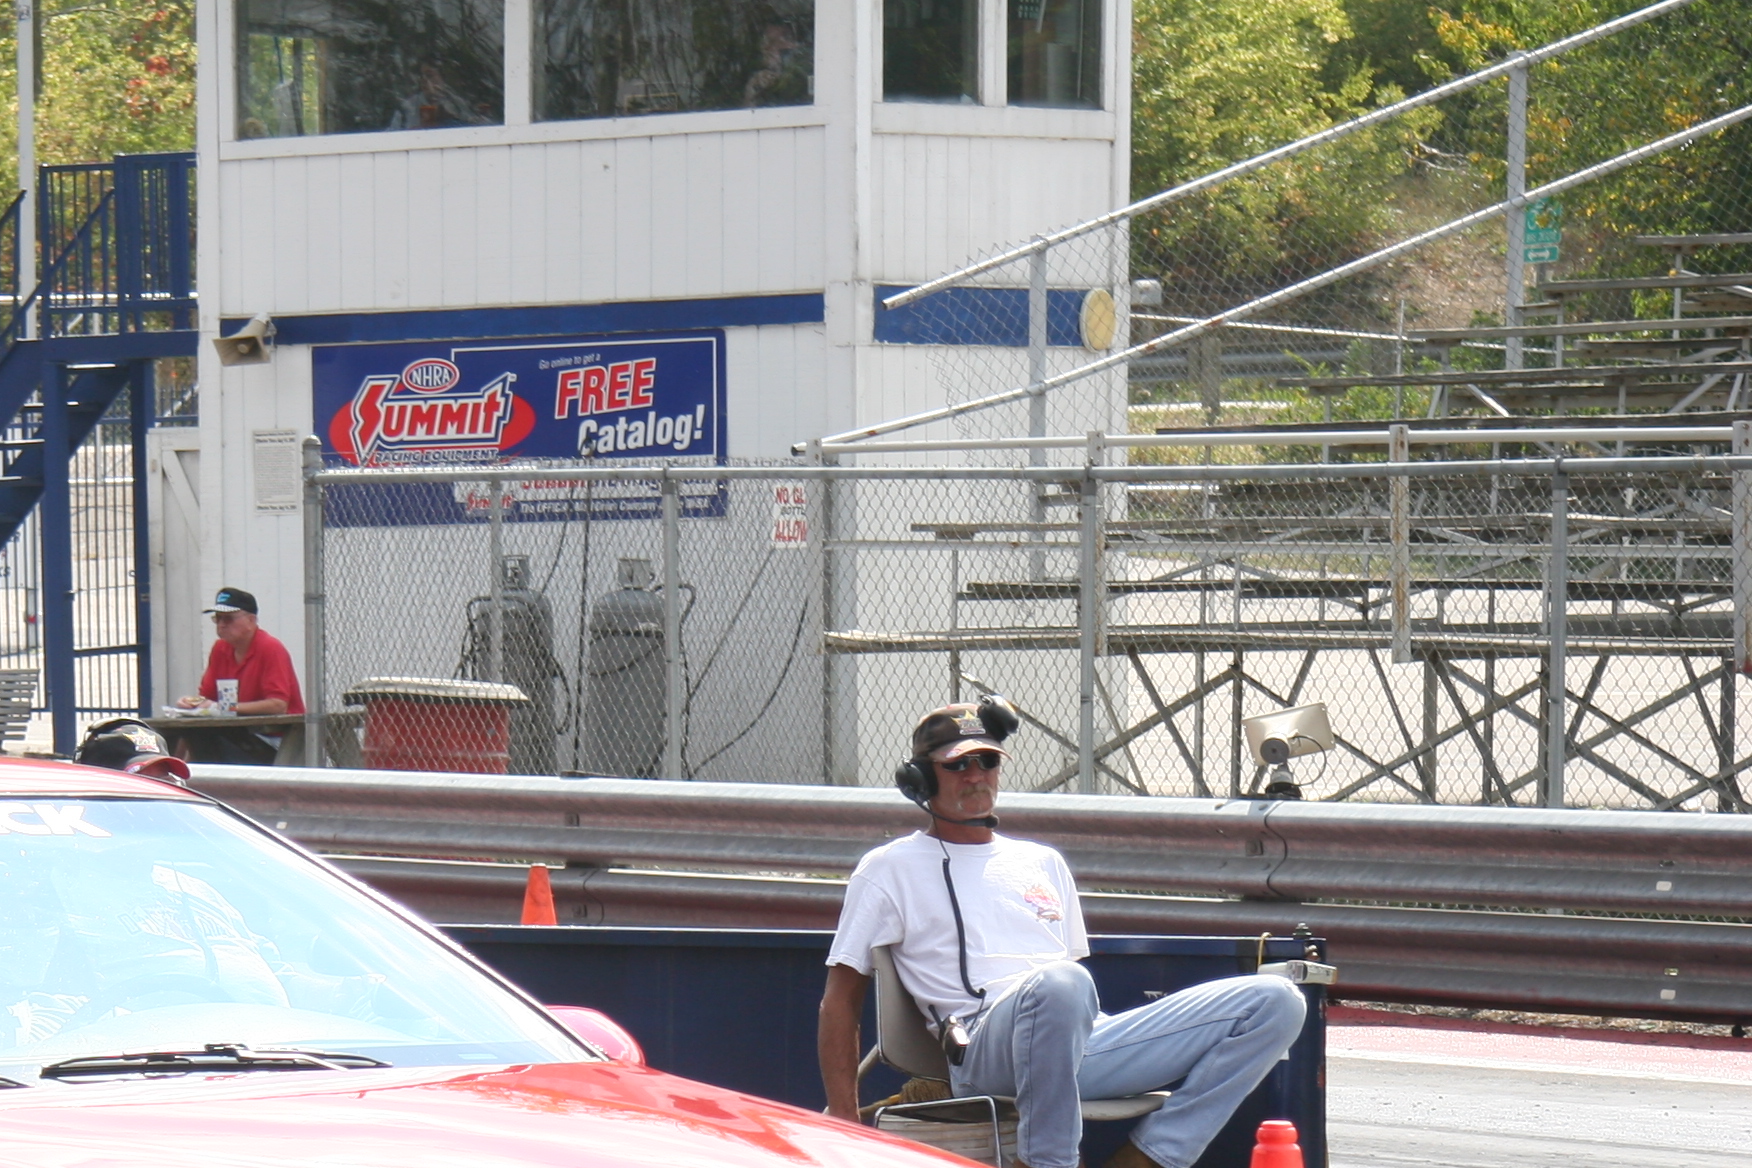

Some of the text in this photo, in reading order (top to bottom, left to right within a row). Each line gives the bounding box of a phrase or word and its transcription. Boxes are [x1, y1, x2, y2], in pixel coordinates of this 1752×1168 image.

[411, 365, 450, 387] NHRA
[554, 357, 656, 420] FREE
[578, 404, 705, 456] Catalog!
[375, 448, 498, 463] RACING EQUIPMENT
